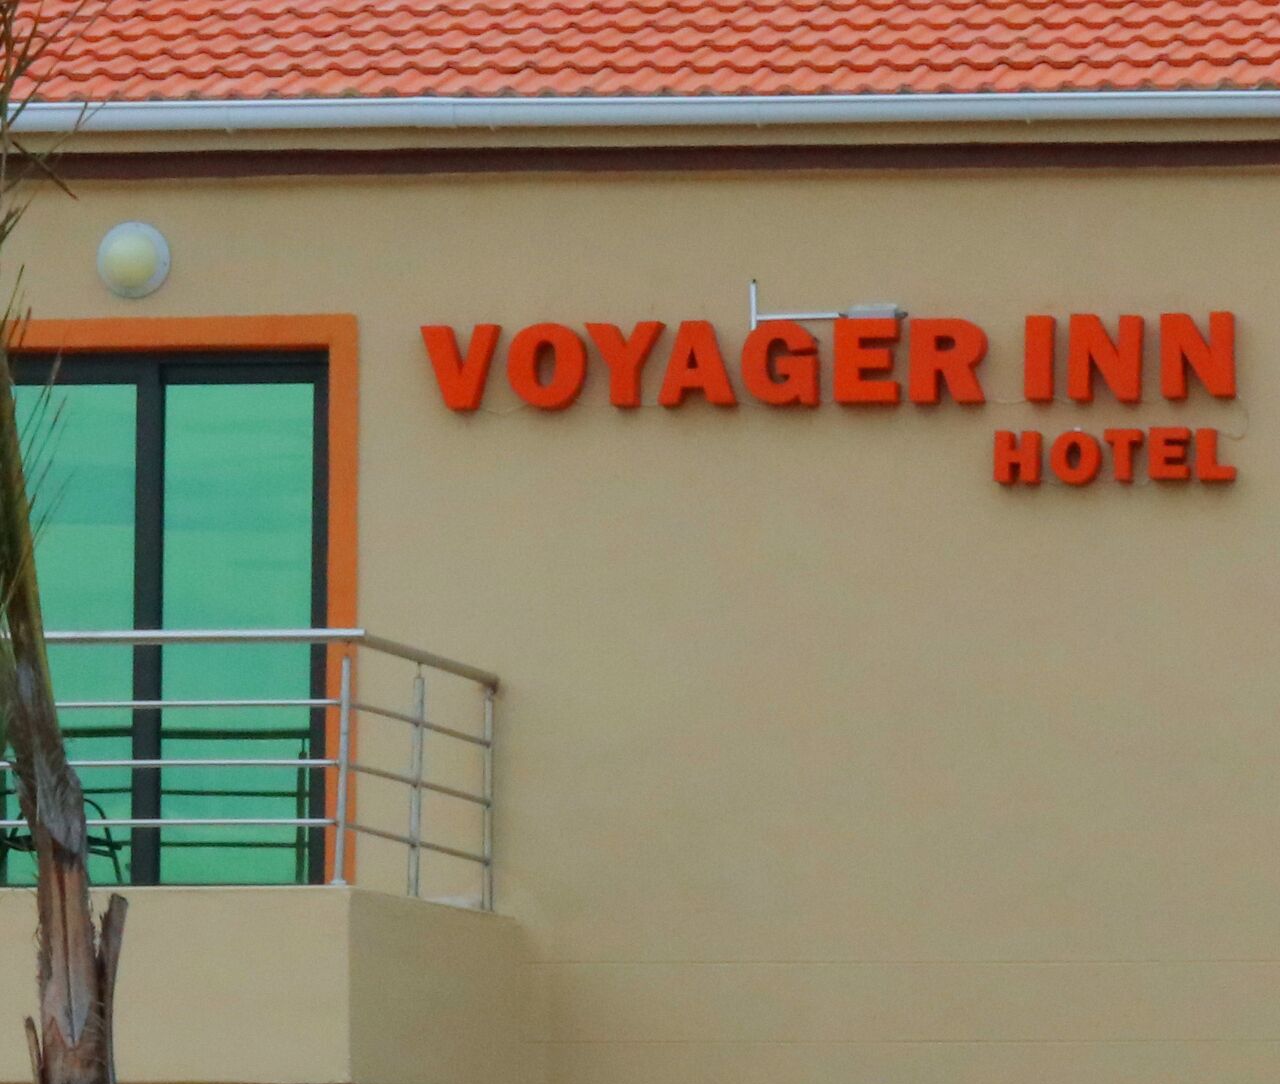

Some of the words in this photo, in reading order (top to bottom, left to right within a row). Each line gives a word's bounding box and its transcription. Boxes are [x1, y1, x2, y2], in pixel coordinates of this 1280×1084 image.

[421, 317, 988, 411] VOYAGER
[1024, 310, 1238, 402] INN
[993, 426, 1238, 487] HOTEL
